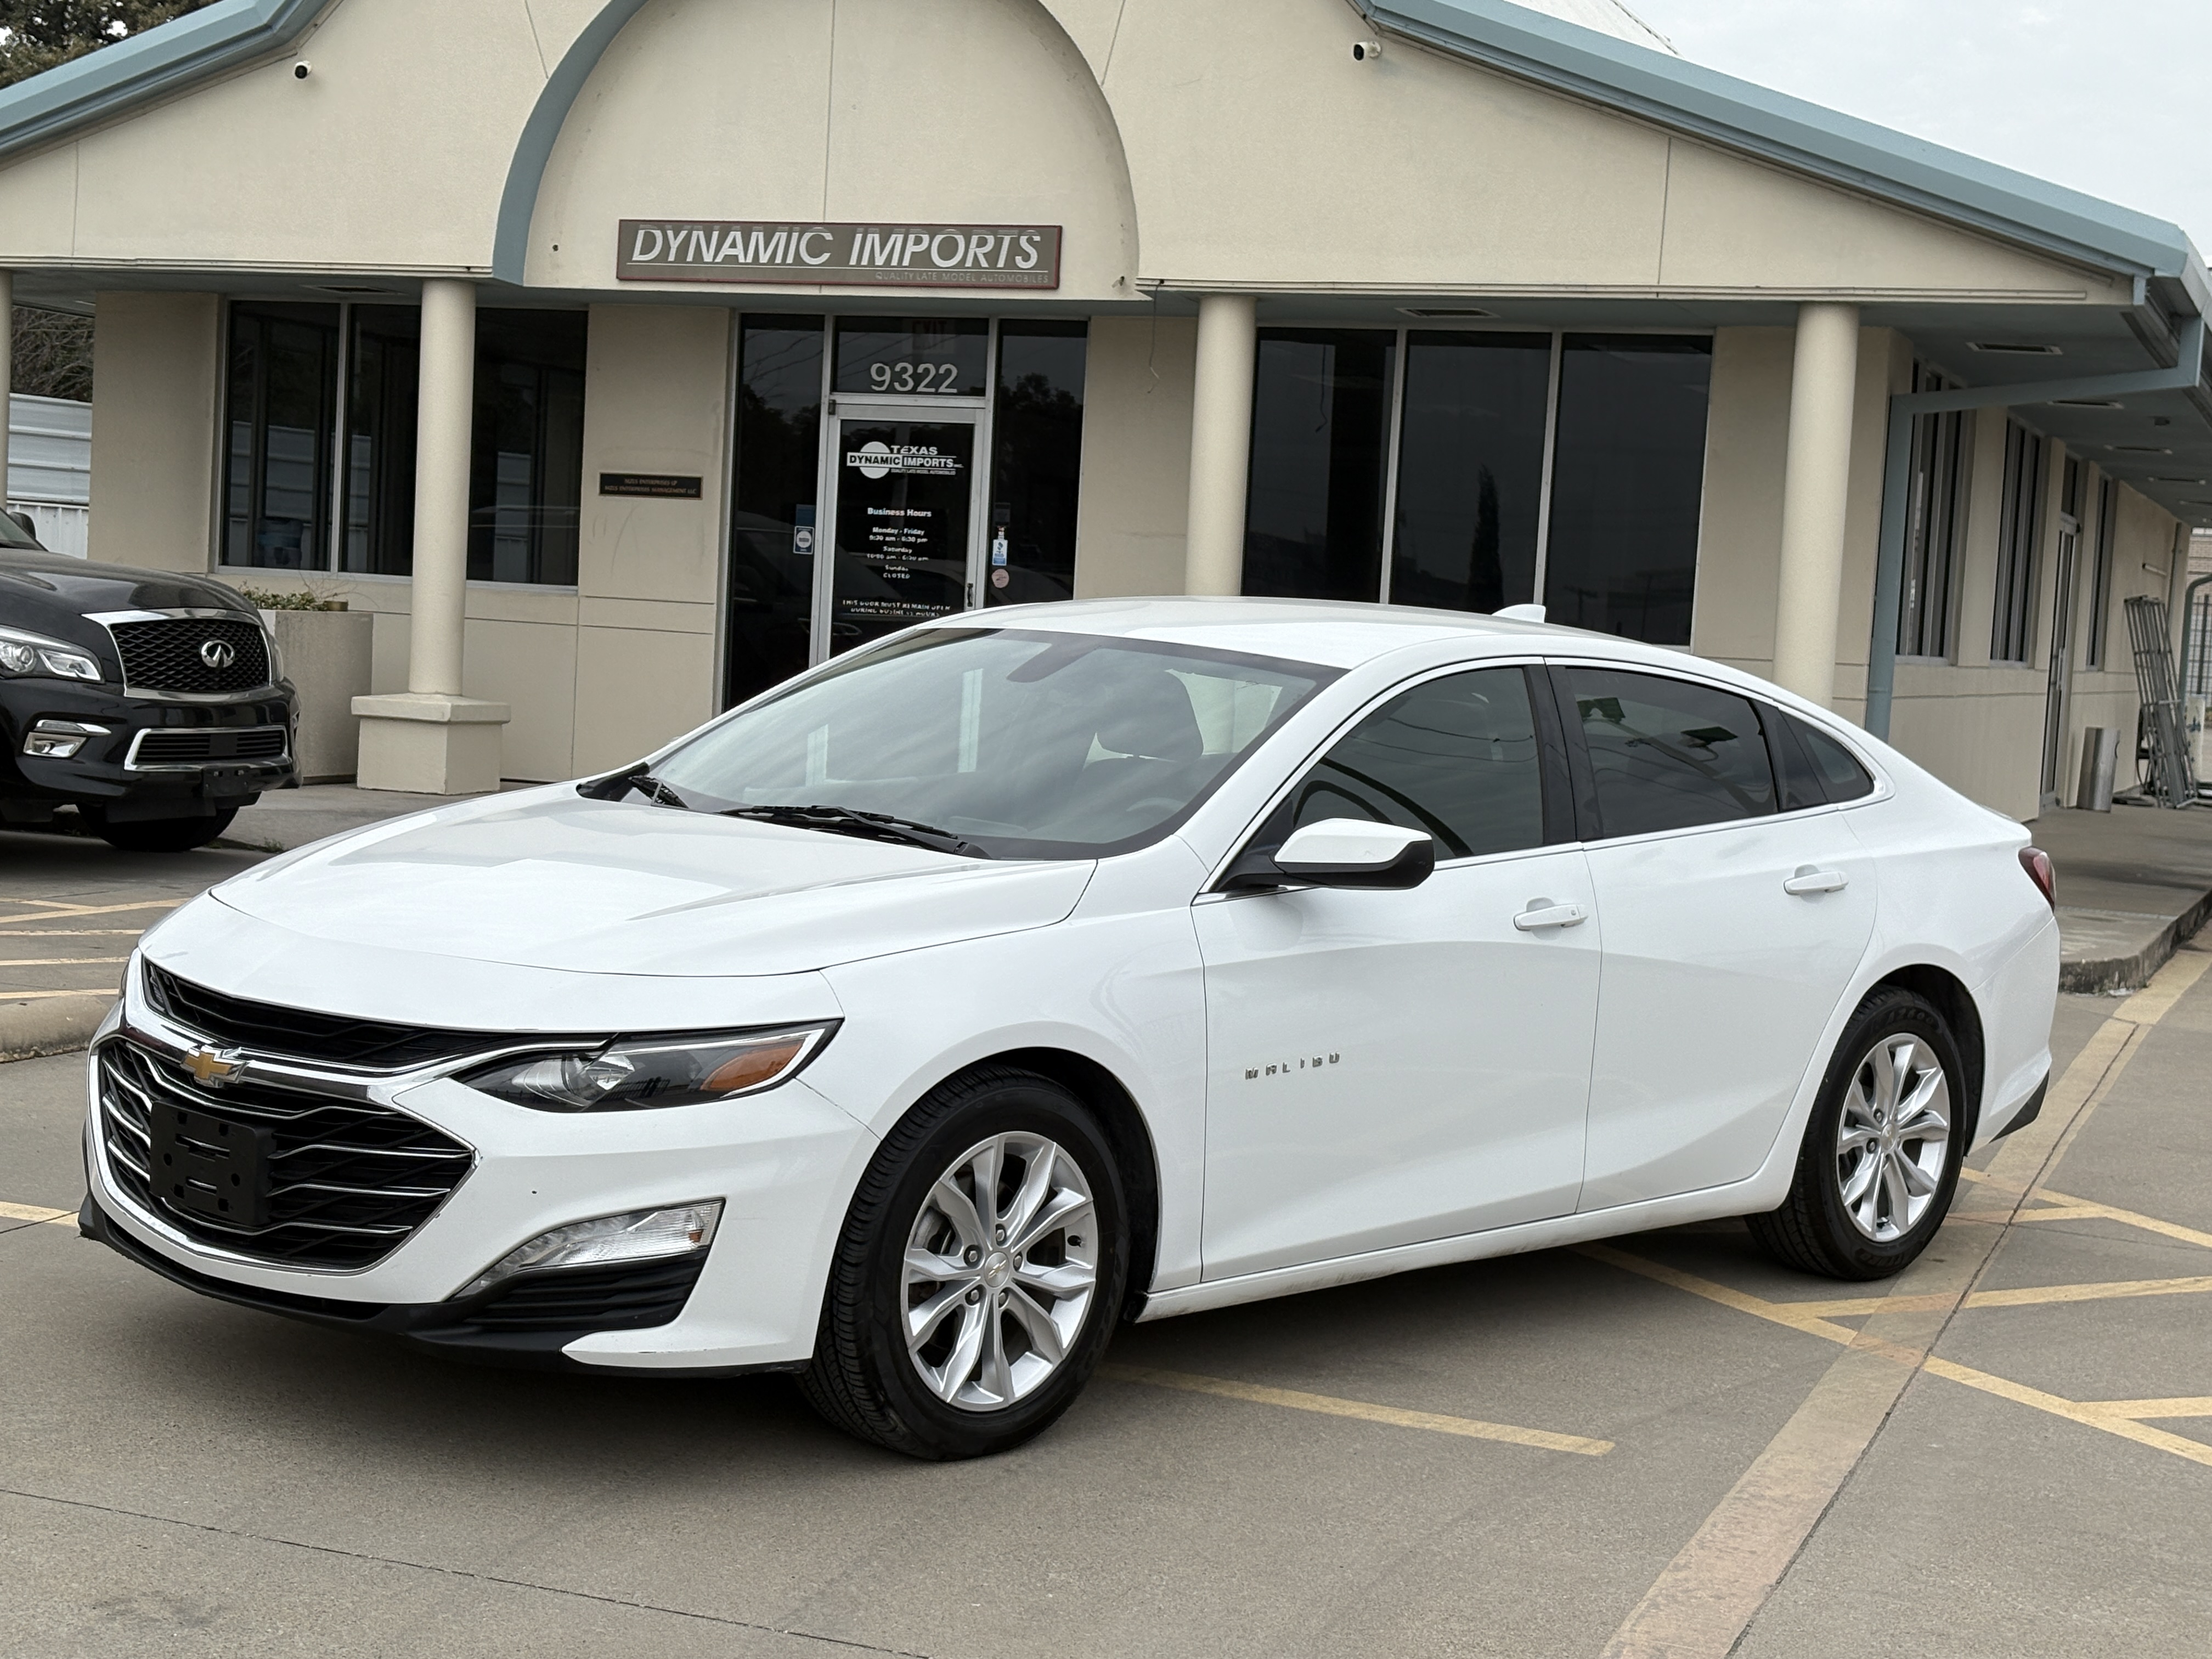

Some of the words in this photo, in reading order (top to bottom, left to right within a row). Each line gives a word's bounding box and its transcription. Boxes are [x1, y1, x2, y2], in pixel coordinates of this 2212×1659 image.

[632, 224, 833, 265] DYNAMIC
[849, 227, 1041, 269] IMPORTS
[875, 272, 913, 280] QUALITY
[916, 273, 937, 281] LATE
[941, 274, 977, 282] MODEL
[980, 274, 1048, 284] AUTOMOBILES
[870, 362, 958, 393] 9322
[890, 445, 938, 455] TEXAS
[850, 455, 901, 465] DYNAMIC
[904, 457, 953, 467] IMPORTS
[867, 507, 905, 516] Business
[907, 509, 932, 517] Hours
[872, 527, 899, 535] Monday
[904, 528, 925, 536] Friday
[883, 546, 912, 554] Saturday
[1245, 1051, 1340, 1080] MALIBU
